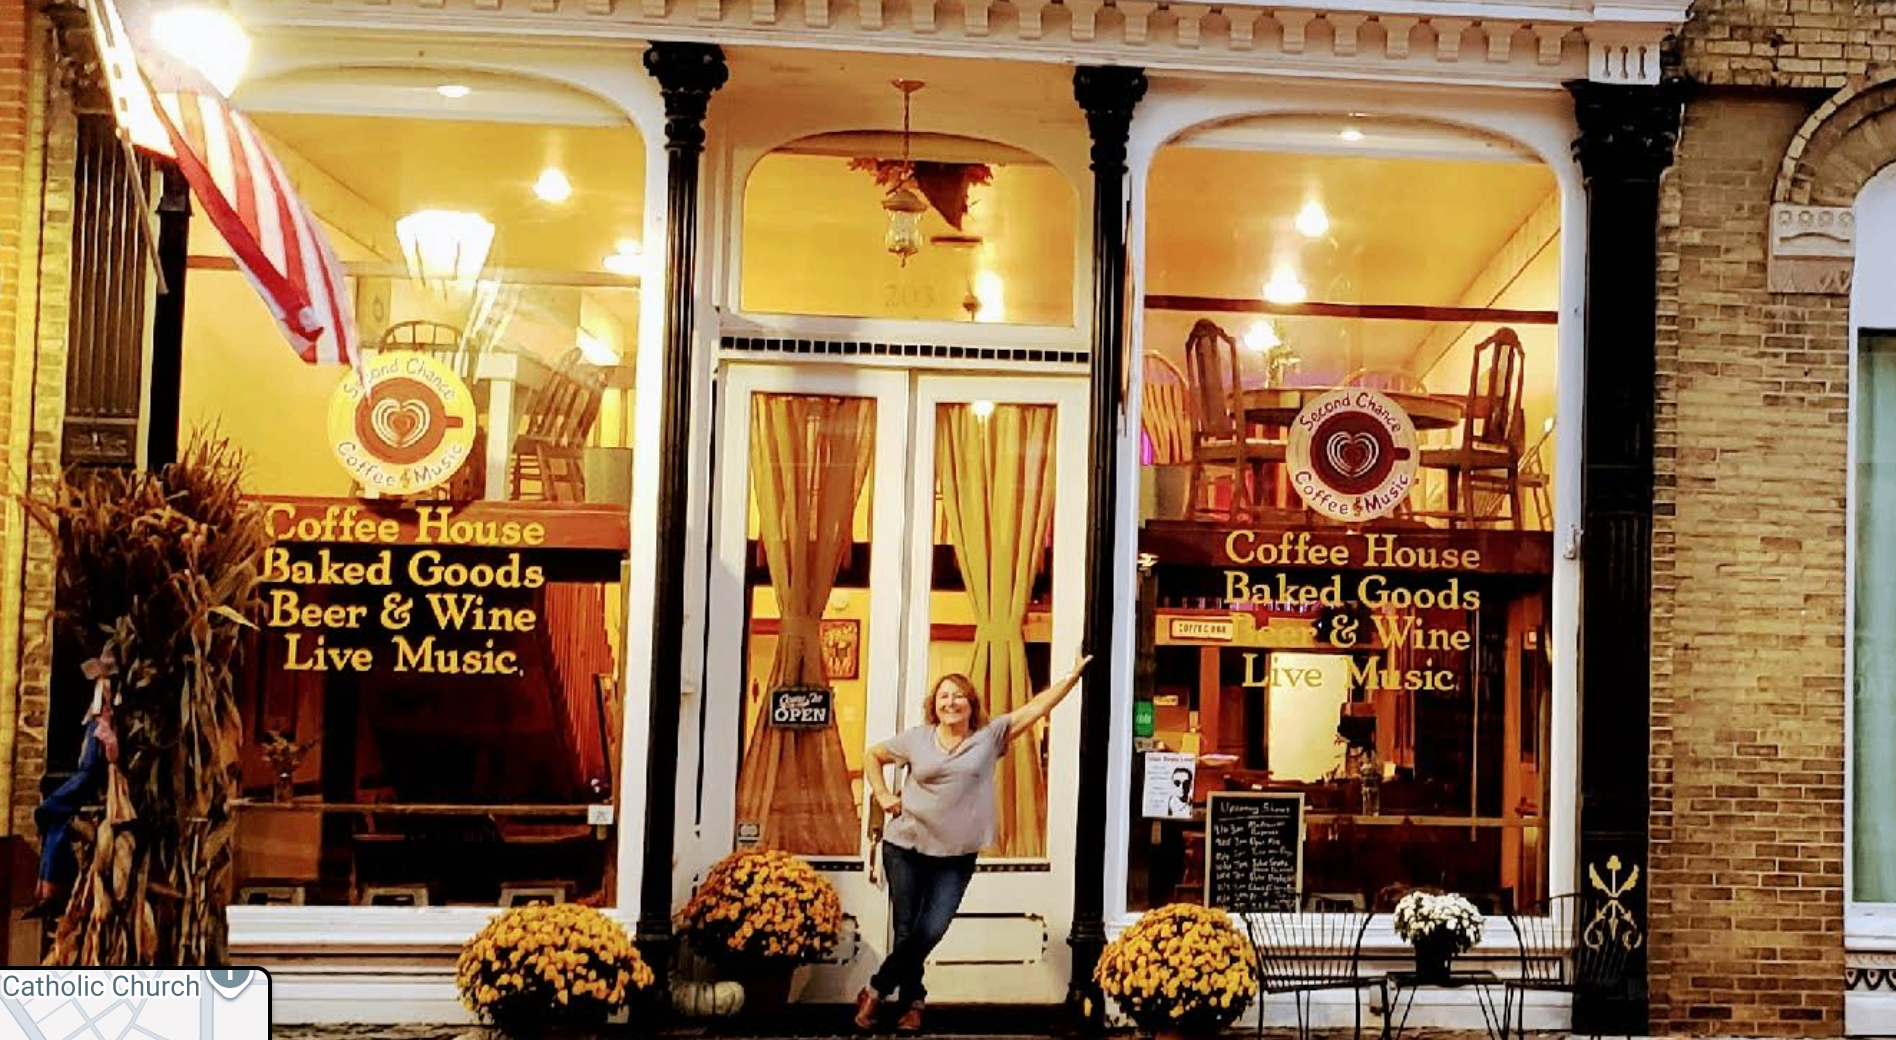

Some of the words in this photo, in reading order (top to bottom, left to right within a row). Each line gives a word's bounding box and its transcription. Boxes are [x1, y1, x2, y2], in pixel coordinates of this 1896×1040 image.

[343, 358, 398, 399] Sond
[407, 358, 456, 400] Chance
[1300, 392, 1350, 431] Second
[1356, 392, 1401, 431] Chance
[338, 442, 395, 487] Coffee
[414, 443, 463, 482] Music
[1296, 471, 1348, 515] Coffee
[1364, 474, 1408, 513] Music
[264, 504, 400, 541] Coffee
[415, 506, 545, 545] House
[263, 548, 392, 585] Baked
[408, 550, 545, 588] Goods
[1225, 531, 1349, 565] Coffee
[1364, 534, 1481, 569] House
[268, 589, 367, 627] Beer
[380, 593, 413, 629] &
[426, 593, 536, 632] Wine
[1224, 571, 1341, 605] Baked
[1358, 575, 1480, 611] Goods
[283, 632, 373, 671] Live
[1330, 615, 1359, 648] &
[1370, 615, 1471, 651] Wine
[1242, 653, 1322, 688] Live
[775, 707, 827, 722] OPEN
